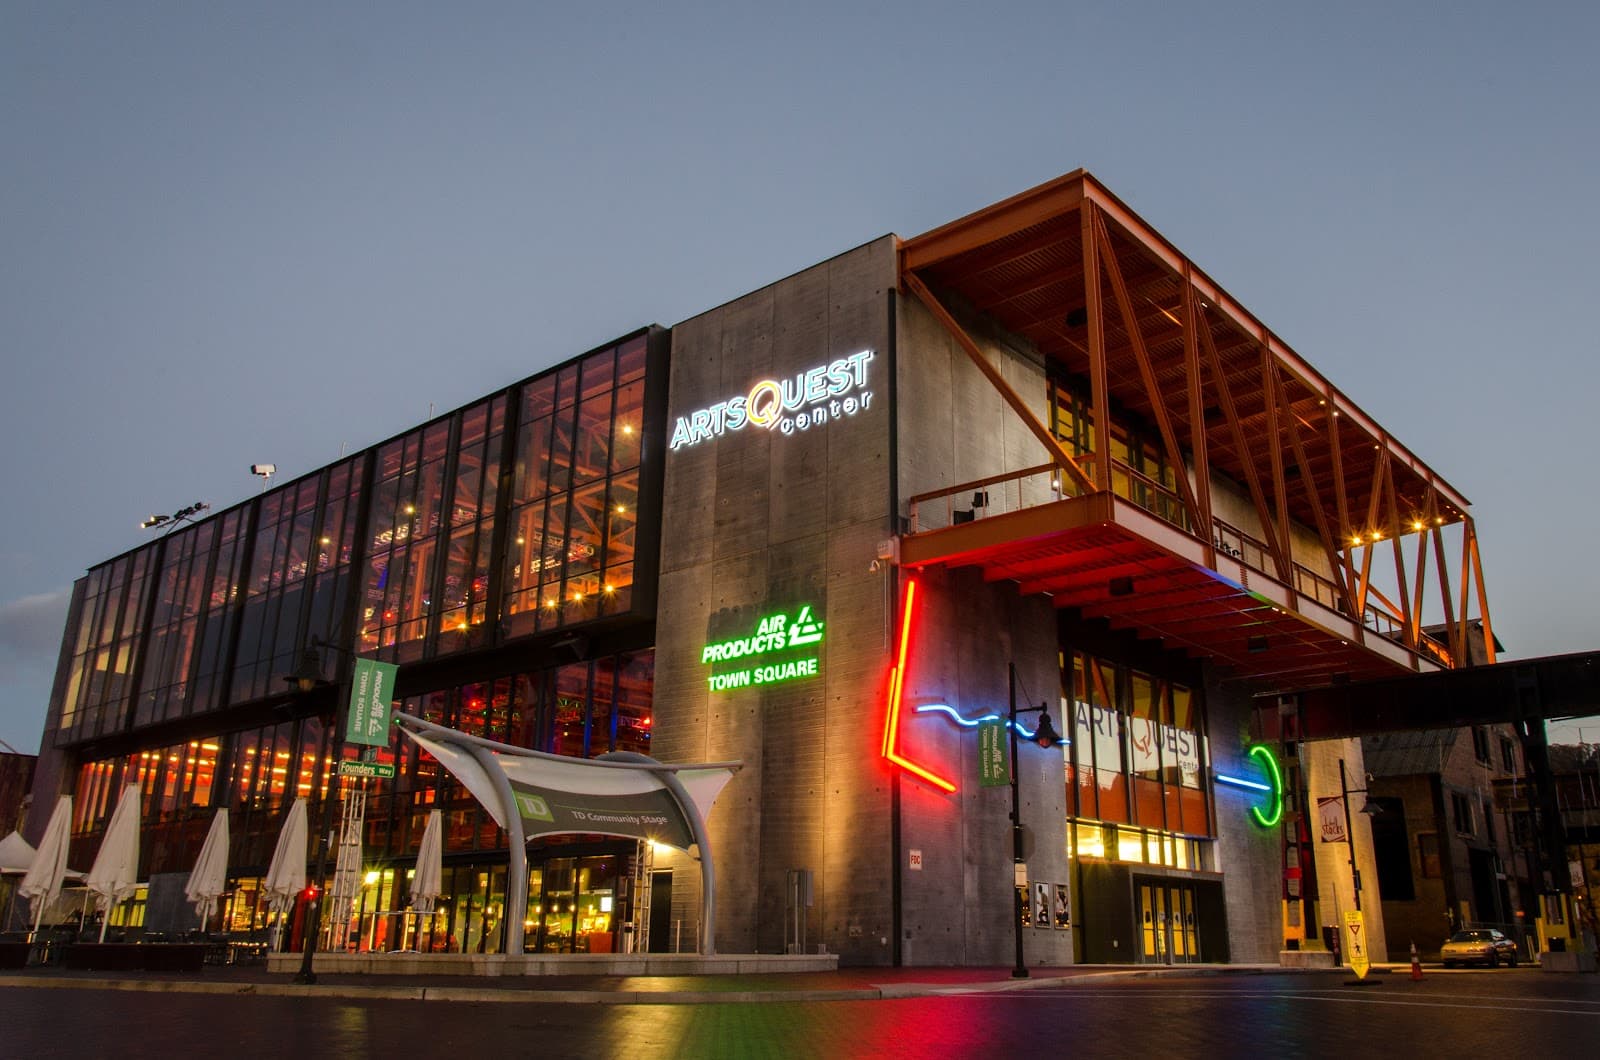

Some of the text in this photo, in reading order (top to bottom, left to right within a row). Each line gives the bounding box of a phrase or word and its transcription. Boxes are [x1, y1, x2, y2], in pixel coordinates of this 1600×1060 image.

[669, 350, 874, 450] ARTSQUEST
[780, 391, 872, 435] center
[757, 614, 787, 636] AIR
[702, 631, 786, 663] PRODUCTS
[708, 658, 817, 691] TOWN SQUARE
[354, 671, 369, 733] TOWN SQUARE
[371, 671, 383, 718] PRODUCTS
[340, 762, 392, 776] Founders Way
[517, 796, 548, 816] TD
[571, 810, 668, 825] TD Community Stage
